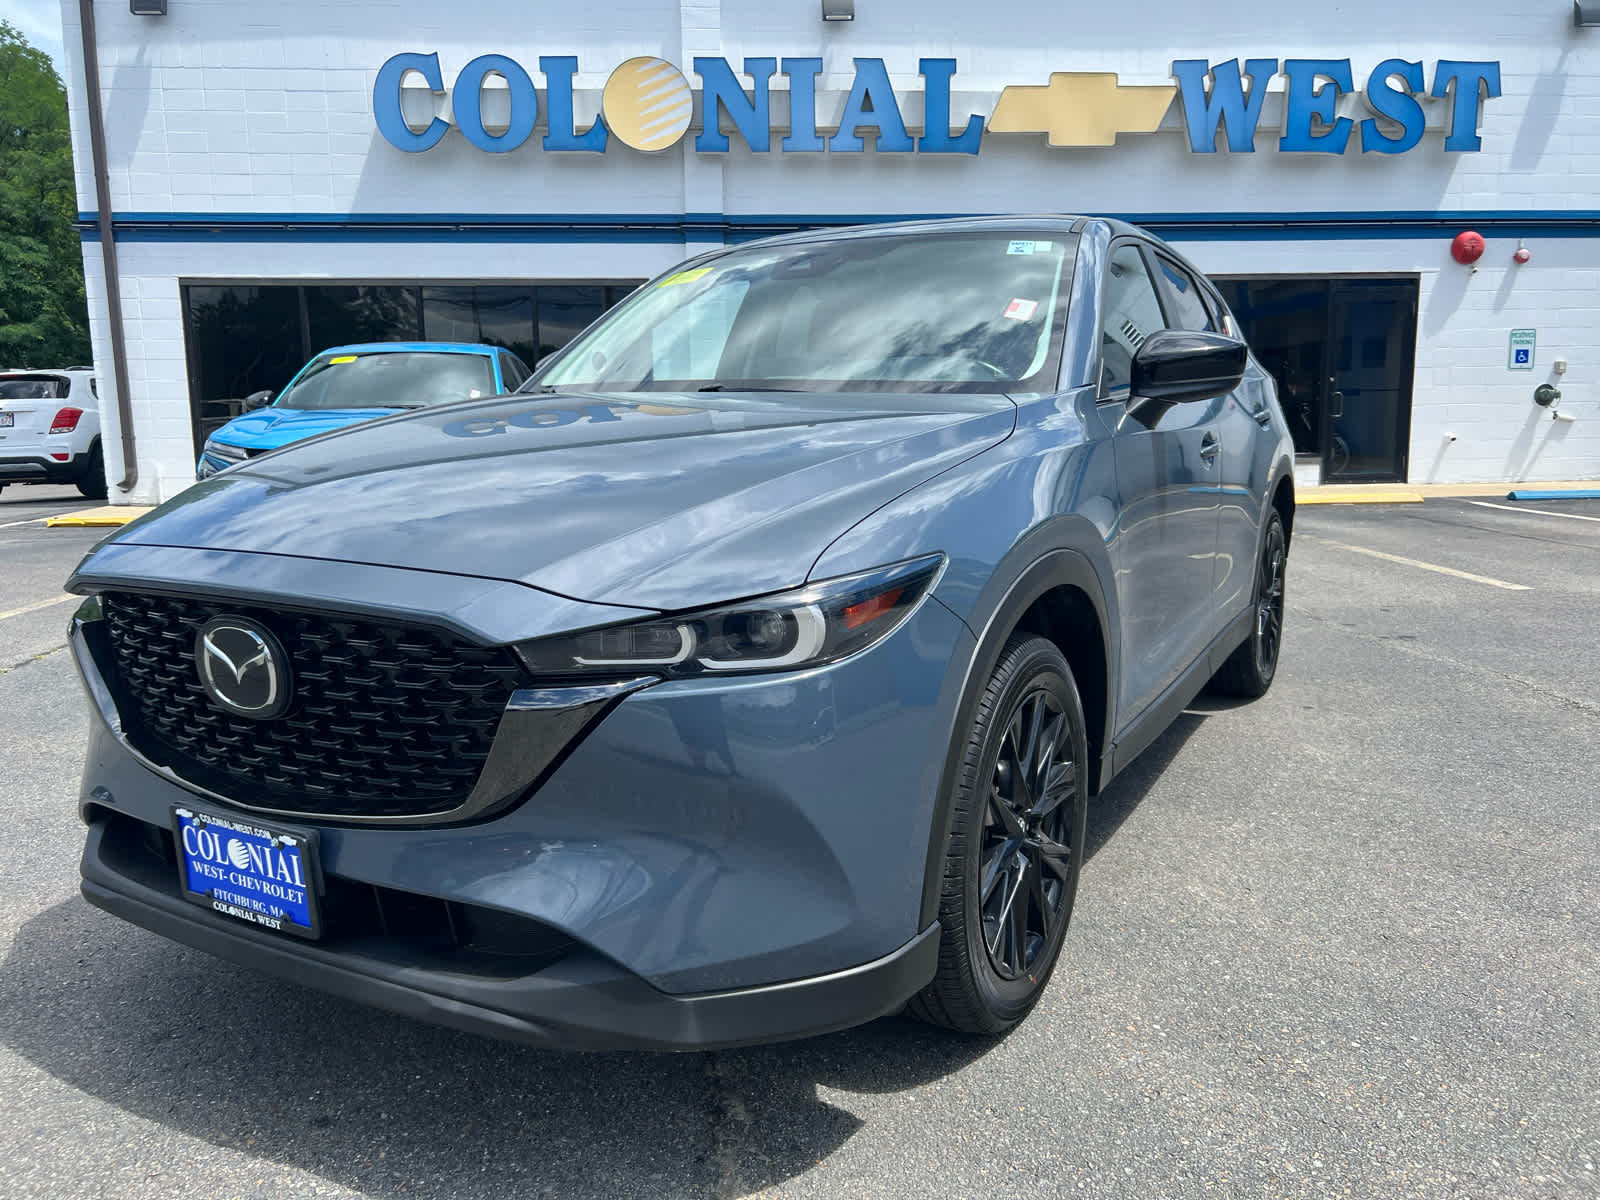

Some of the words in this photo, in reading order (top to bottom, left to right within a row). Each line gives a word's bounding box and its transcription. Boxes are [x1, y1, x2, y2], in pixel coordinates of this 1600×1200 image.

[373, 51, 985, 155] COLONIAL
[1170, 57, 1502, 155] WEST
[182, 824, 307, 888] COLONIAL
[212, 900, 257, 922] COLONIAL
[256, 914, 281, 930] WEST
